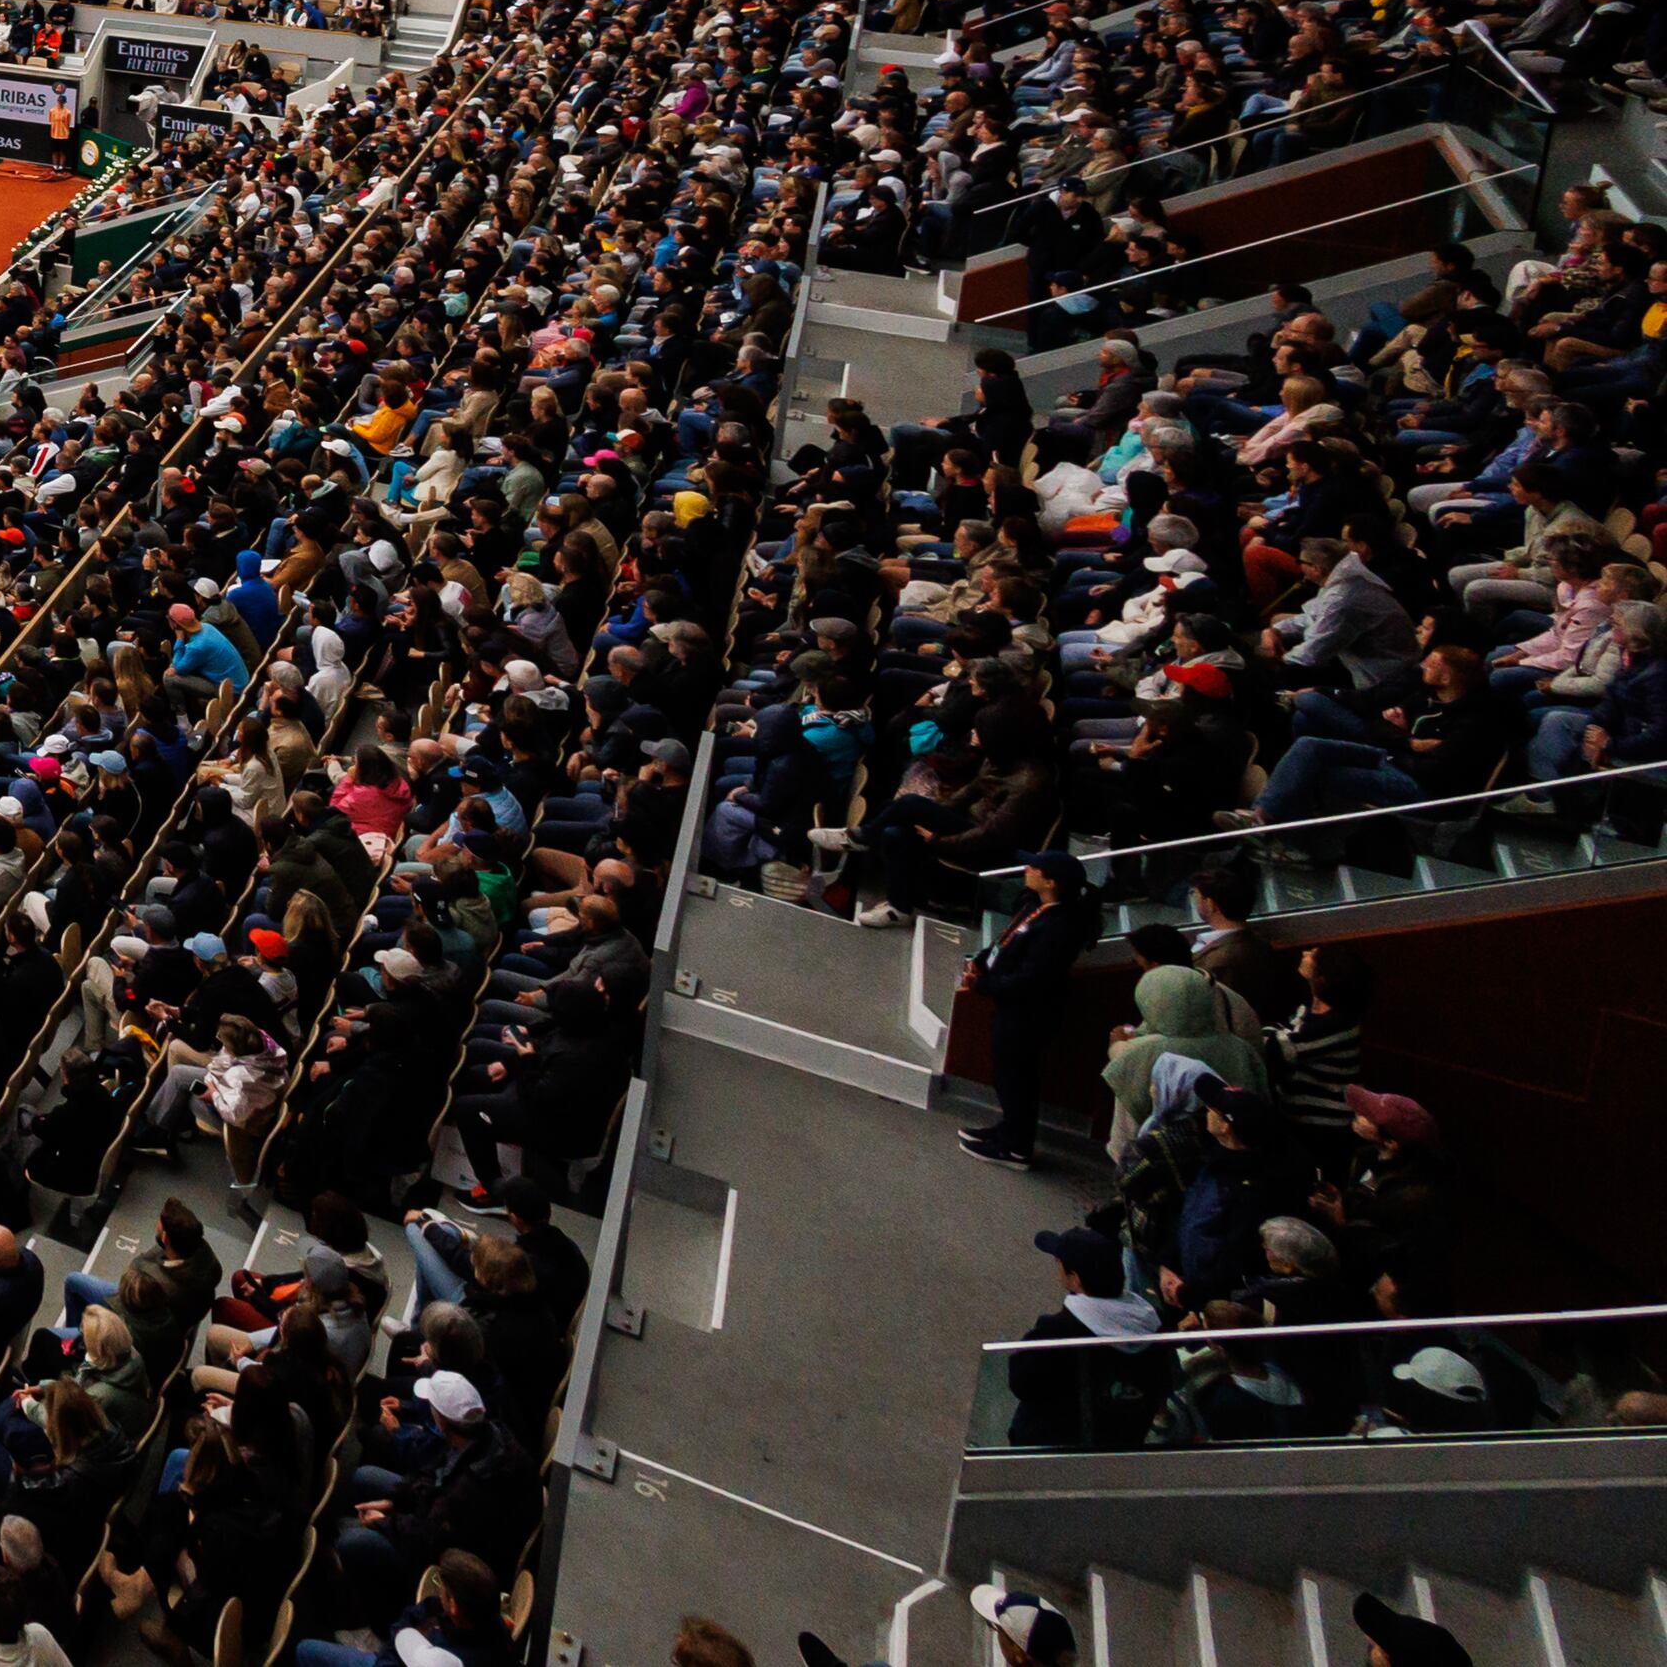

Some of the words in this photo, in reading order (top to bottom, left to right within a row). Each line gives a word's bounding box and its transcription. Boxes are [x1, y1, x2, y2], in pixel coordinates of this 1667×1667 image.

[117, 40, 189, 62] Emirates
[127, 57, 143, 70] FLY
[144, 59, 178, 74] BETTER
[161, 116, 225, 136] Emires
[634, 1471, 668, 1502] 16
